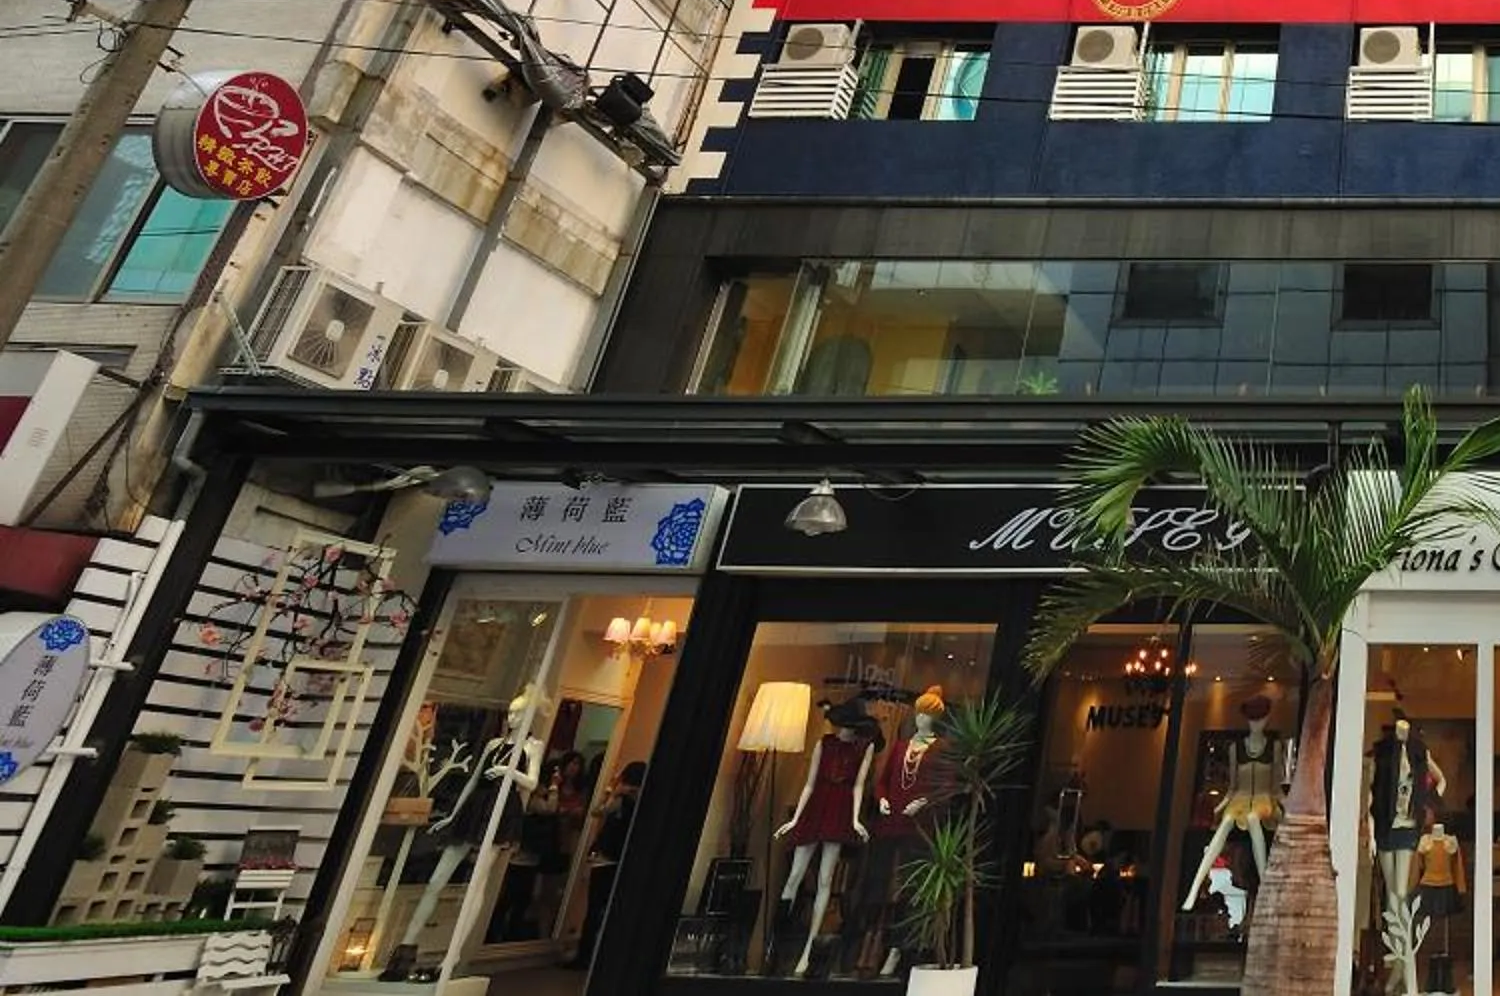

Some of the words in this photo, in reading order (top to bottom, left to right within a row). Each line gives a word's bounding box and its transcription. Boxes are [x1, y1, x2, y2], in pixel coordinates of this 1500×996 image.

[519, 495, 633, 523] 薄荷藍
[515, 534, 569, 555] Mint
[574, 534, 612, 555] blue
[1378, 535, 1485, 573] iona's
